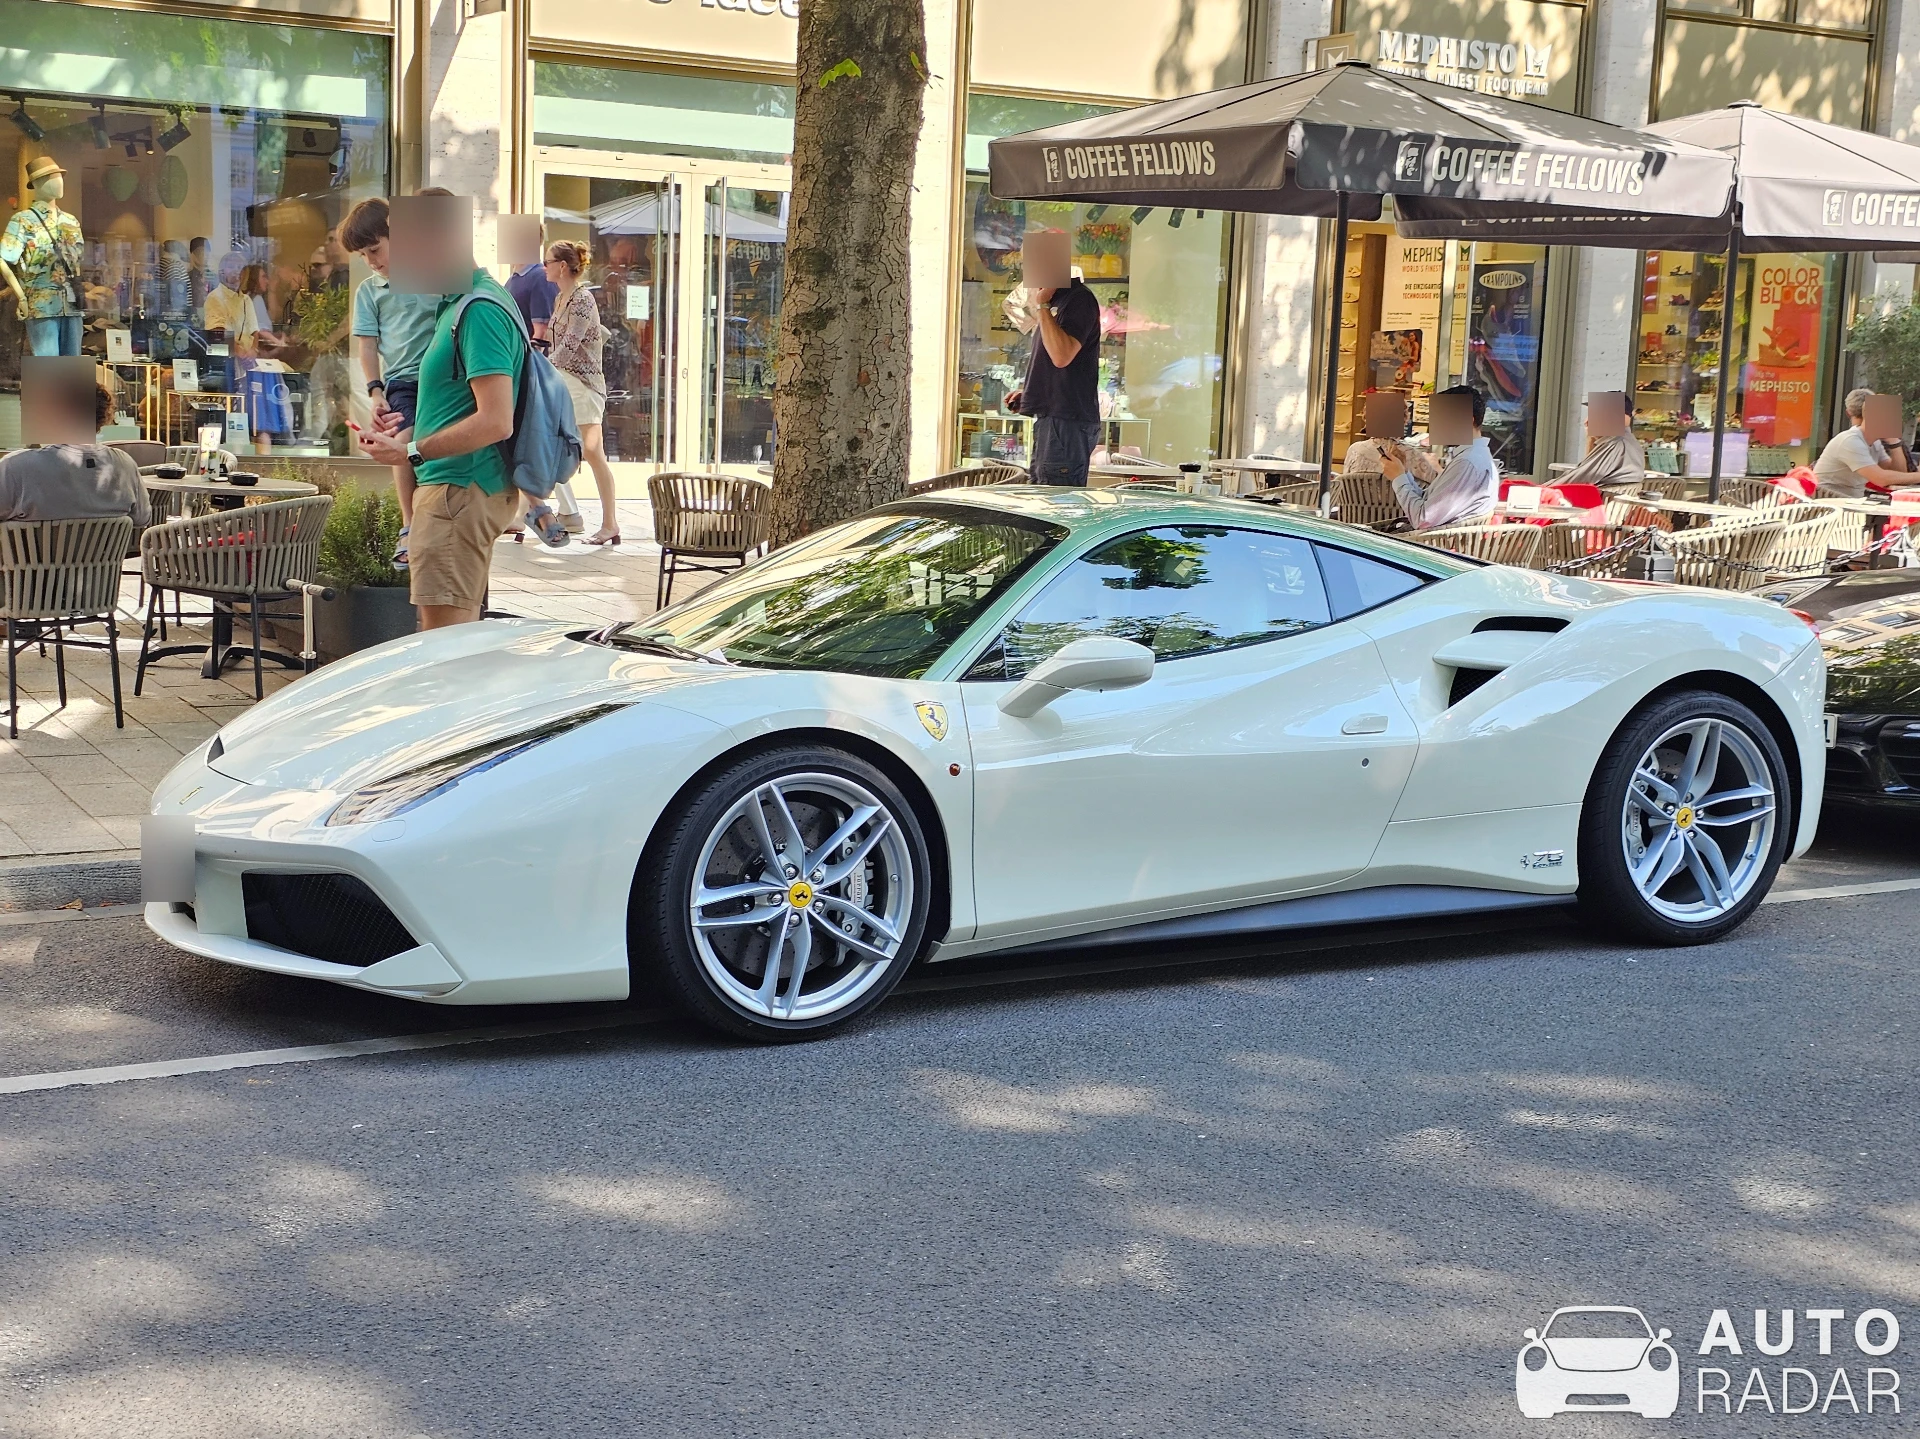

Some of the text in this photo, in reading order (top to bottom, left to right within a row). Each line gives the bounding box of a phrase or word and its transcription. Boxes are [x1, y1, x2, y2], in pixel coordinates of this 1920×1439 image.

[1377, 29, 1518, 74] MEPHISTO
[1437, 71, 1481, 91] FINEST
[1485, 76, 1549, 97] FOOTWEAR
[1064, 140, 1216, 180] COFFEE FELLOWS
[1431, 146, 1645, 196] COFFEE FELLOWS
[1402, 247, 1443, 262] MEPHIS
[1483, 273, 1523, 287] TRAMPOLINS
[1762, 267, 1820, 287] COLOR
[1760, 286, 1819, 305] BLOCK
[1749, 380, 1811, 394] MEPHISTO
